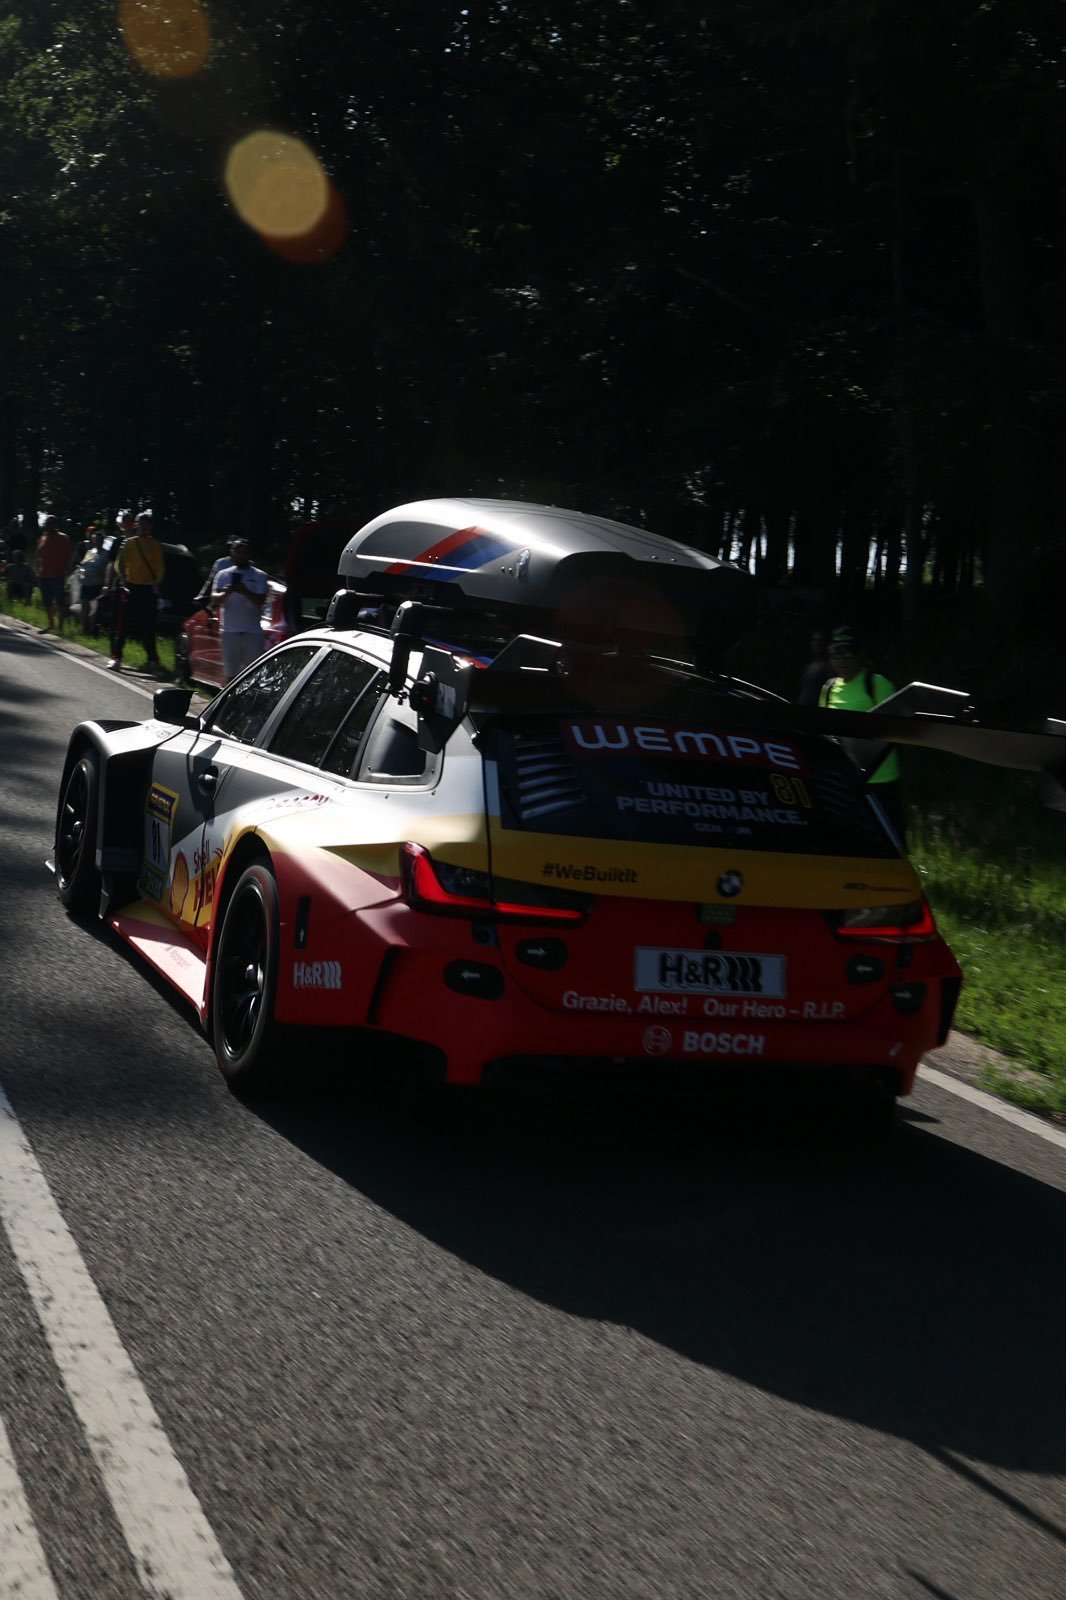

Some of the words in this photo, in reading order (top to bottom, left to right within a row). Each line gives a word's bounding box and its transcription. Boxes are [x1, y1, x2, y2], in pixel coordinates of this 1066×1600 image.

[571, 725, 800, 769] WEMPE
[646, 781, 735, 804] UNITED
[738, 789, 769, 806] BY
[769, 773, 812, 808] 81
[616, 796, 809, 826] PERFORMANCE.
[293, 961, 321, 988] H&R
[659, 952, 722, 986] H&R
[562, 990, 632, 1015] Grazie,
[637, 995, 688, 1015] Alex!
[703, 1000, 740, 1018] Our
[742, 1001, 787, 1019] Hero
[682, 1030, 766, 1056] BOSCH
